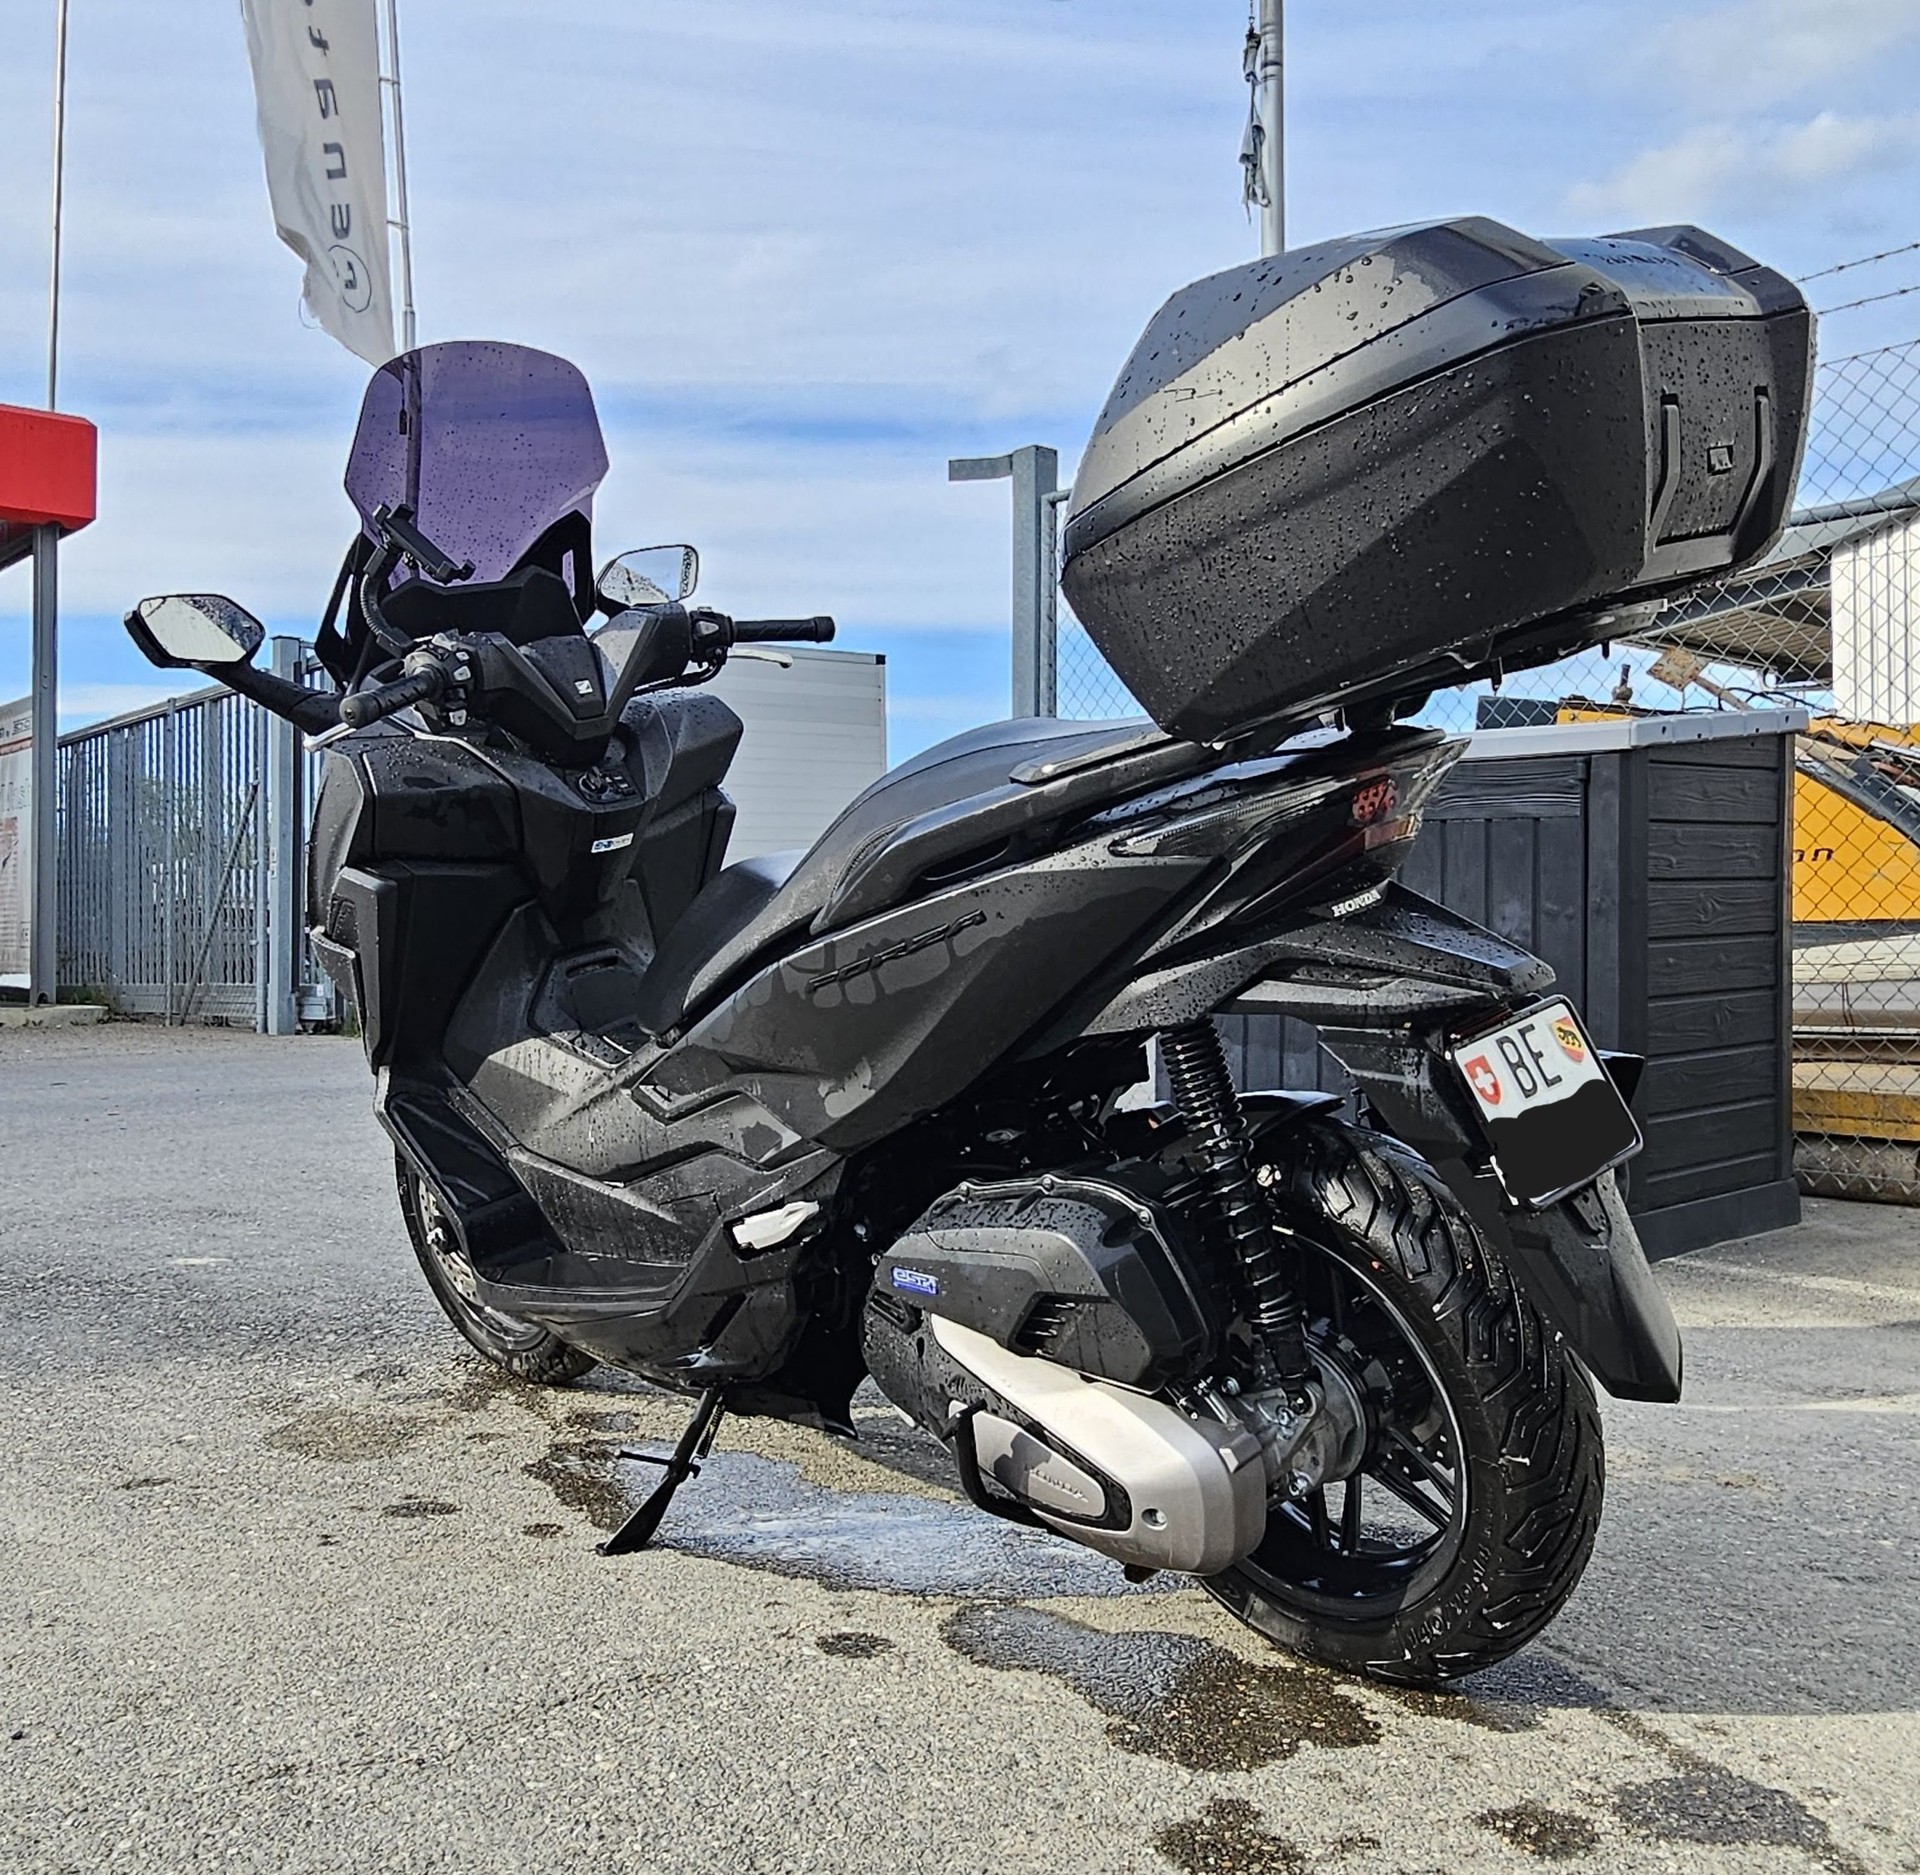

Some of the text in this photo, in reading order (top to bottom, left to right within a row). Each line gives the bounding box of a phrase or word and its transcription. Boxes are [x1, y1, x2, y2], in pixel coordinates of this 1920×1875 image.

[1331, 889, 1382, 918] HONDA
[805, 909, 988, 994] FORZA
[1496, 1023, 1563, 1099] BE
